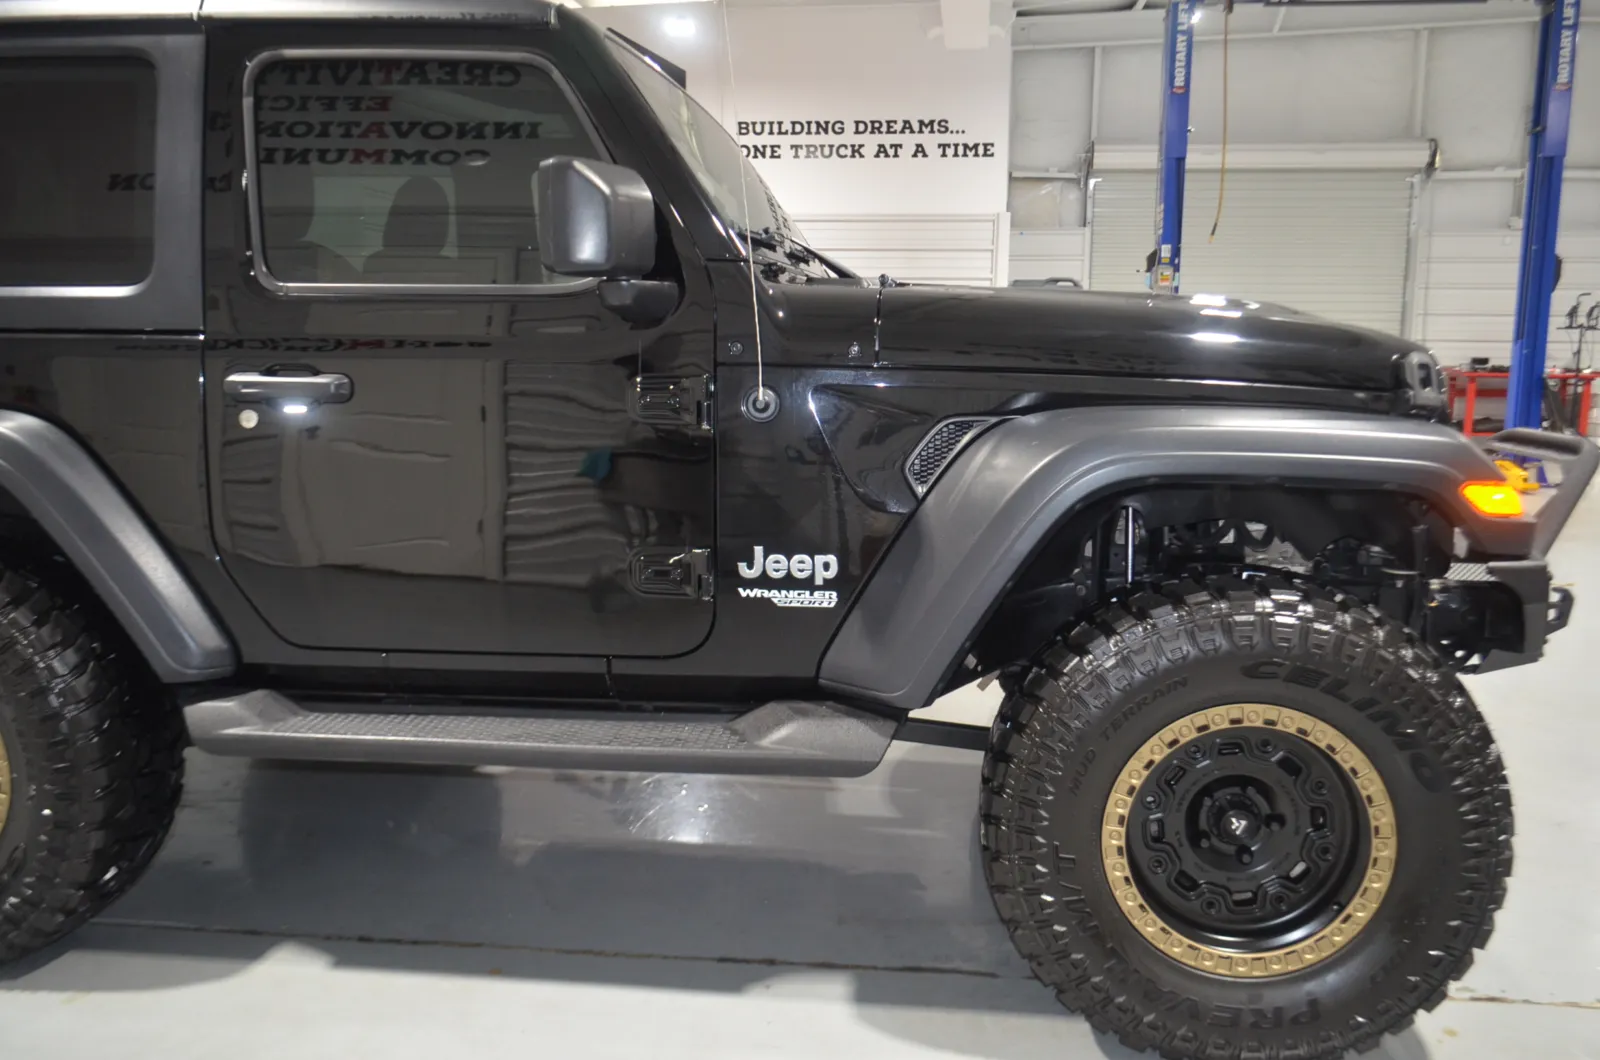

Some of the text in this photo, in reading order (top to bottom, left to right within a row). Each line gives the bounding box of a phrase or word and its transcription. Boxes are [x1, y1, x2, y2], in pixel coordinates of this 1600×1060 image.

[1174, 34, 1188, 87] ROTARY
[1556, 29, 1573, 84] ROTARY
[737, 119, 966, 136] BUILDING DREAMS...
[790, 144, 865, 158] TRUCK
[874, 143, 904, 158] AT
[911, 143, 929, 157] A
[937, 142, 995, 158] TIME
[737, 545, 838, 585] Jeep
[738, 588, 838, 599] WRANGLER
[775, 598, 836, 607] SPORT
[1067, 676, 1189, 797] MUD TERRAIN
[1240, 660, 1444, 793] CELIMO
